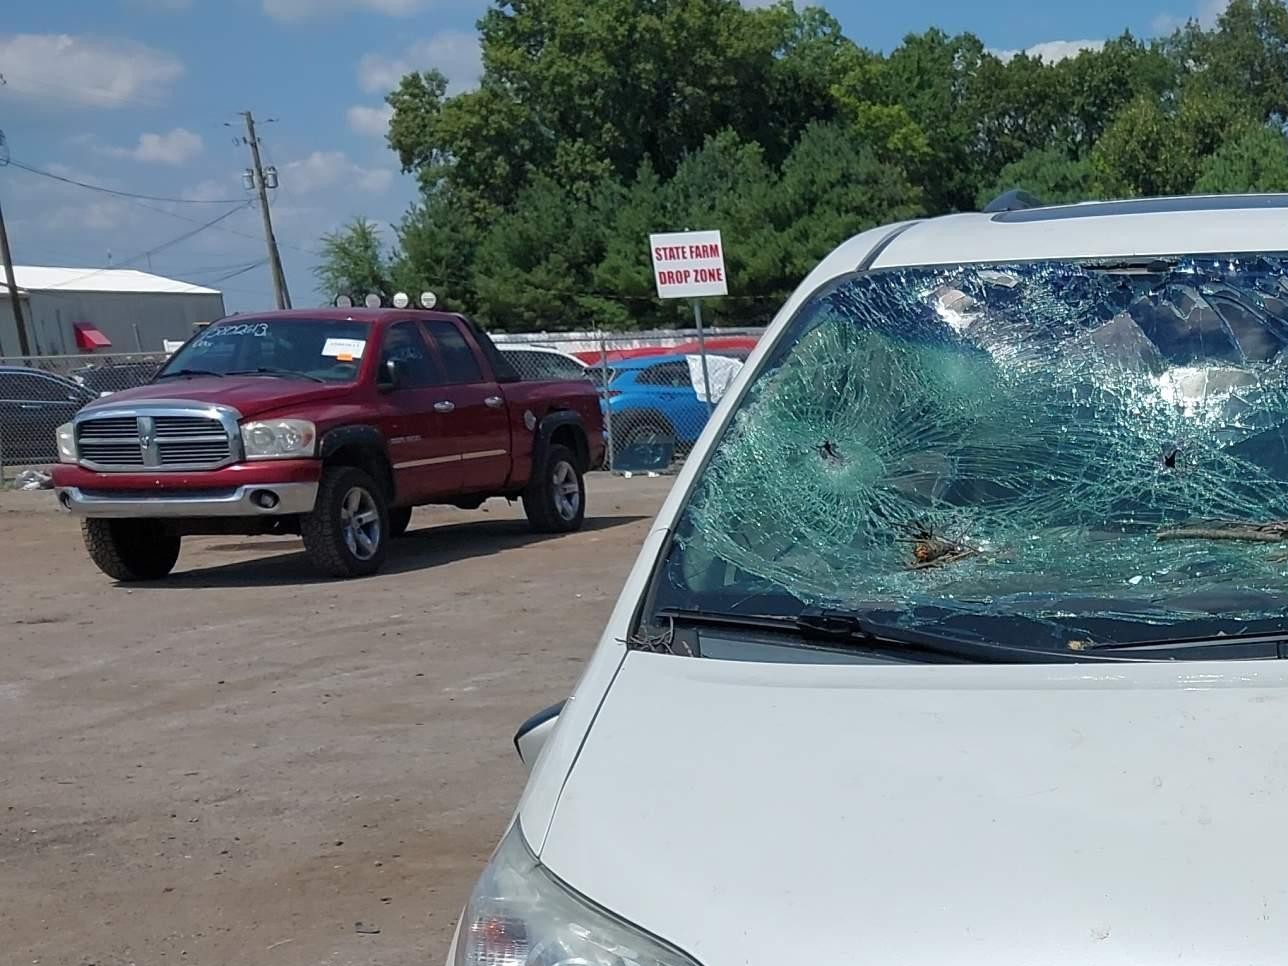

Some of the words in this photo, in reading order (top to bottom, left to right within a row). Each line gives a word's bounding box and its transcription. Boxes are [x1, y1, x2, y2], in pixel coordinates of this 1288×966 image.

[655, 246, 687, 261] STATE
[689, 244, 720, 259] FARM
[659, 270, 690, 285] DROP
[693, 268, 724, 283] ZONE
